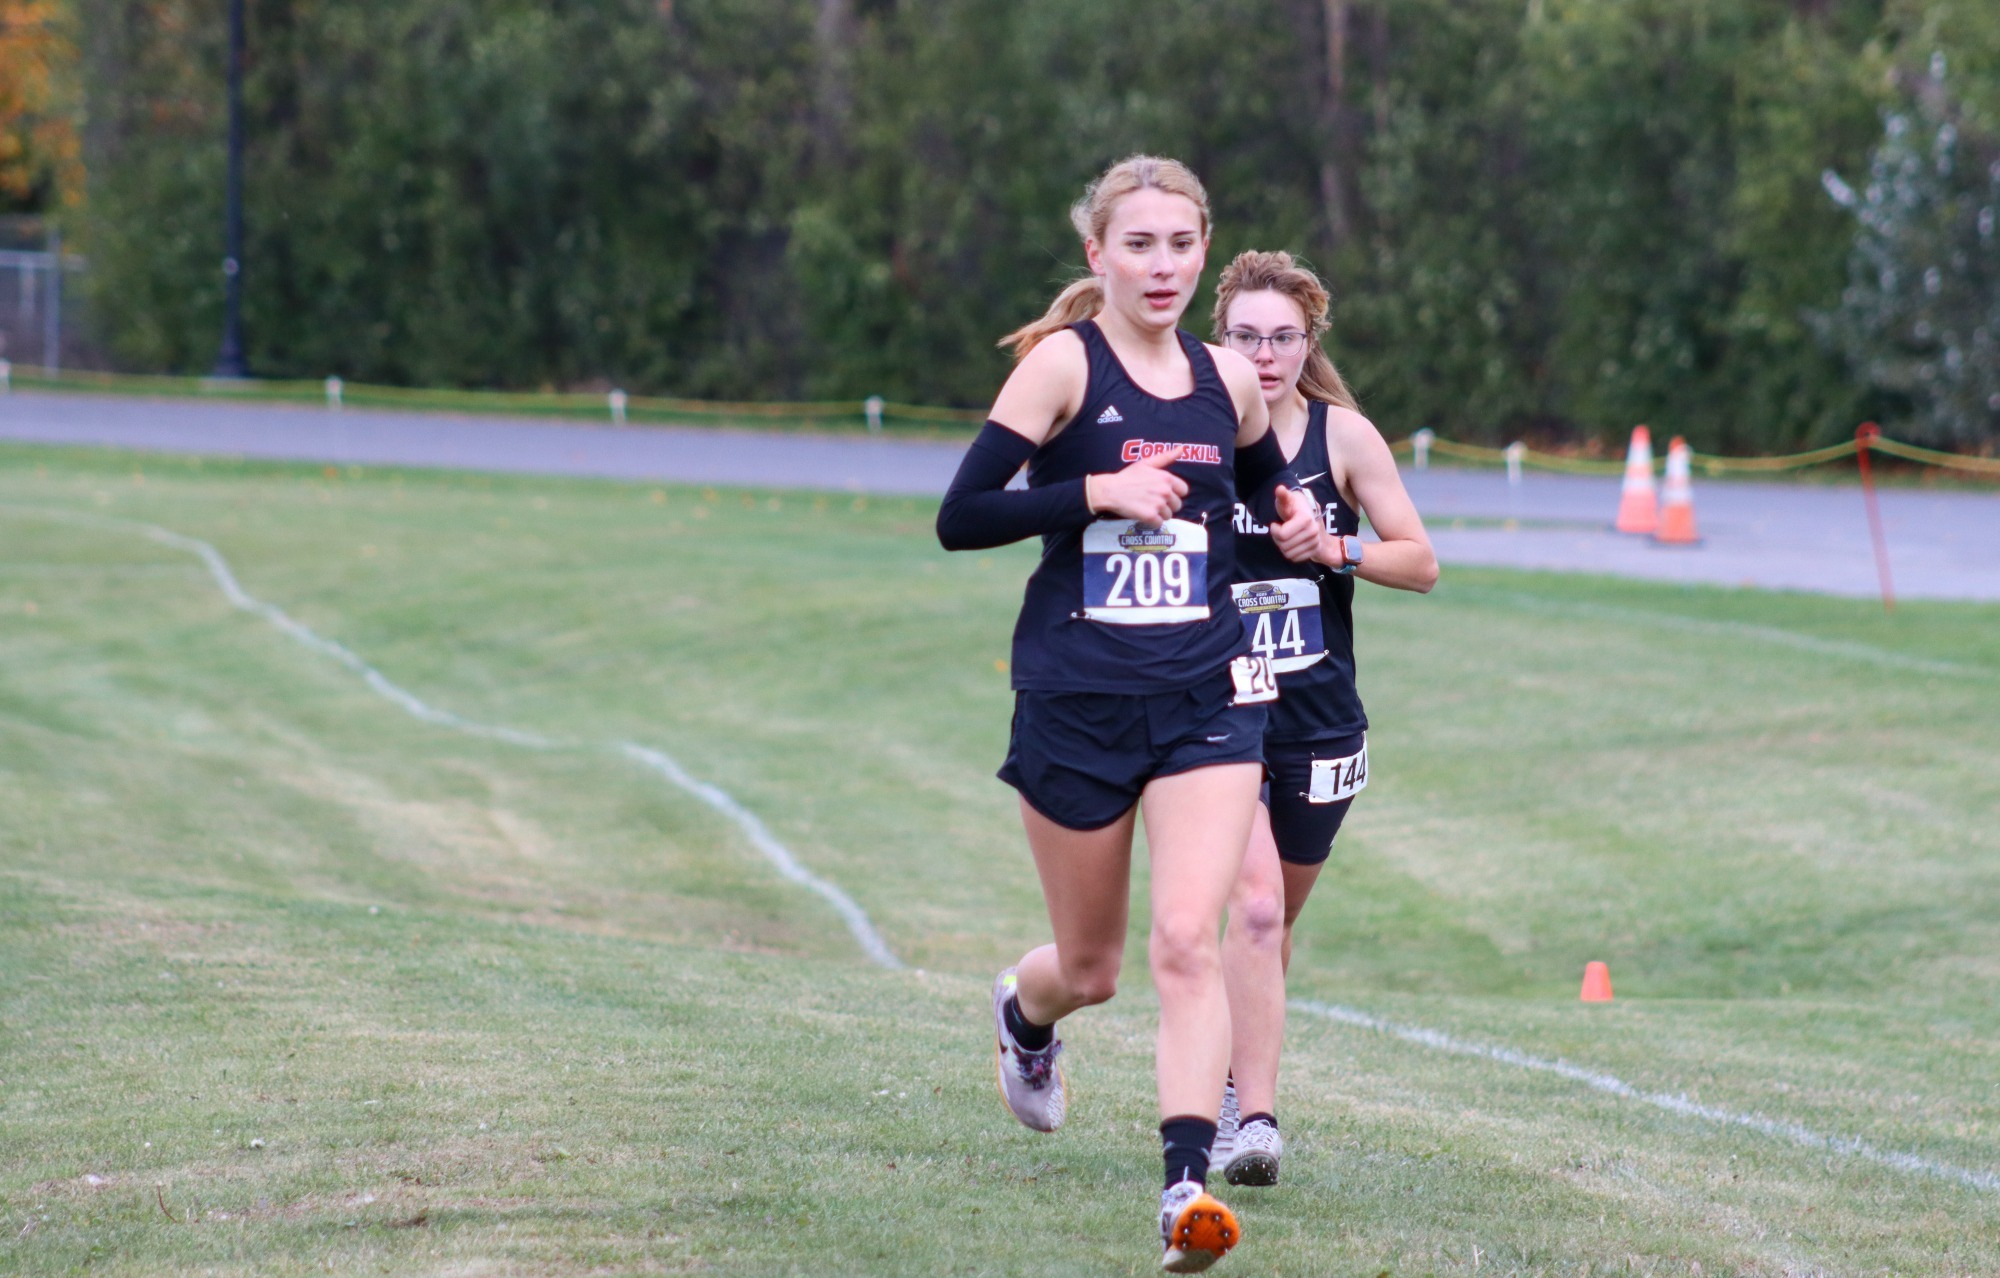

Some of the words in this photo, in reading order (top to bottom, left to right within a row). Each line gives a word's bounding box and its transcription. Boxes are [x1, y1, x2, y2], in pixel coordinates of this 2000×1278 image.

[1097, 415, 1123, 424] adidas
[1121, 535, 1143, 545] CROSS
[1144, 535, 1174, 545] COUNTRY
[1106, 553, 1190, 606] 209
[1238, 597, 1258, 607] CROSS
[1259, 594, 1287, 605] COUNTRY
[1251, 608, 1305, 659] 44
[1331, 750, 1366, 795] 144
